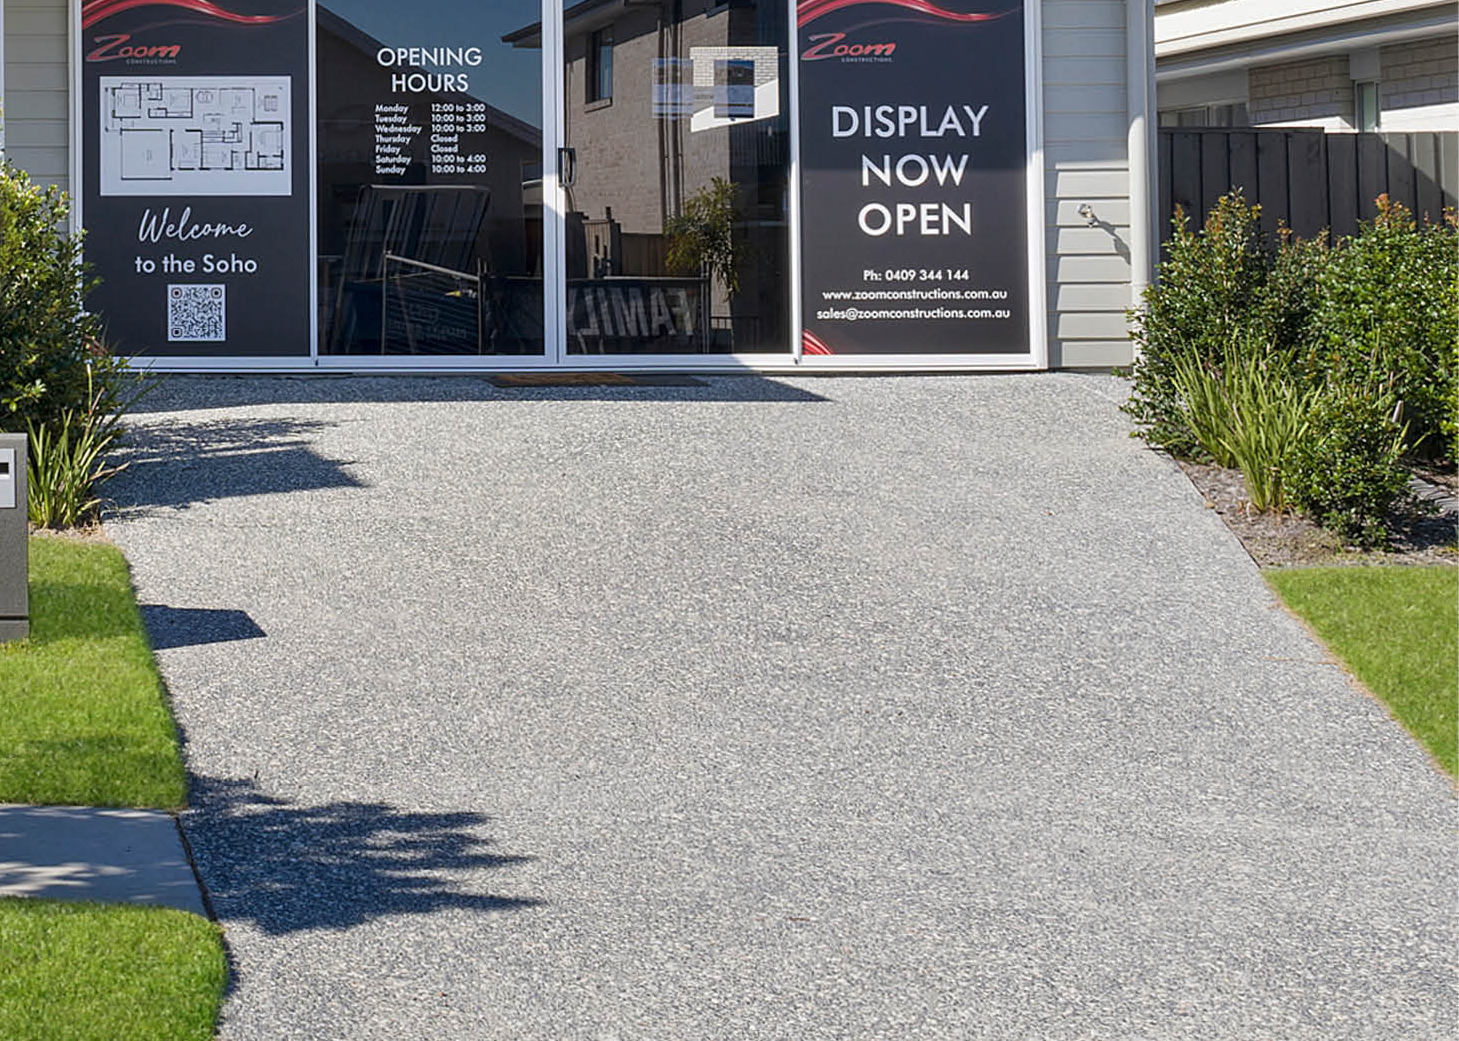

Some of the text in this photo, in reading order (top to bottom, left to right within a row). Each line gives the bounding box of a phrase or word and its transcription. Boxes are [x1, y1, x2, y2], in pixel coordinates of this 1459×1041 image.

[85, 34, 181, 62] Zoom
[801, 32, 897, 61] Zoom
[377, 47, 483, 66] OPENING
[392, 73, 469, 93] HOURS
[375, 103, 486, 114] Monday 12:00 to 3:00
[375, 113, 486, 124] Tuesday 10:00 to 3:00
[832, 105, 989, 138] DISPLAY
[375, 124, 486, 134] Wednesday 10:00 to 3:00
[375, 134, 458, 145] Thursday Closed
[375, 144, 459, 155] Friday Closed
[375, 154, 487, 165] Saturday 10:00 to 4:00
[375, 164, 487, 175] Sunday 10:00 to 4:00
[861, 153, 969, 187] NOW
[139, 206, 253, 243] Welcome
[858, 203, 972, 236] OPEN
[135, 253, 258, 273] to the Soho
[863, 269, 969, 281] Ph: 0409 344 144
[822, 287, 1008, 300] www.zoomconstructions.com.au
[816, 306, 1011, 321] sales@zoomconstructions.com.au
